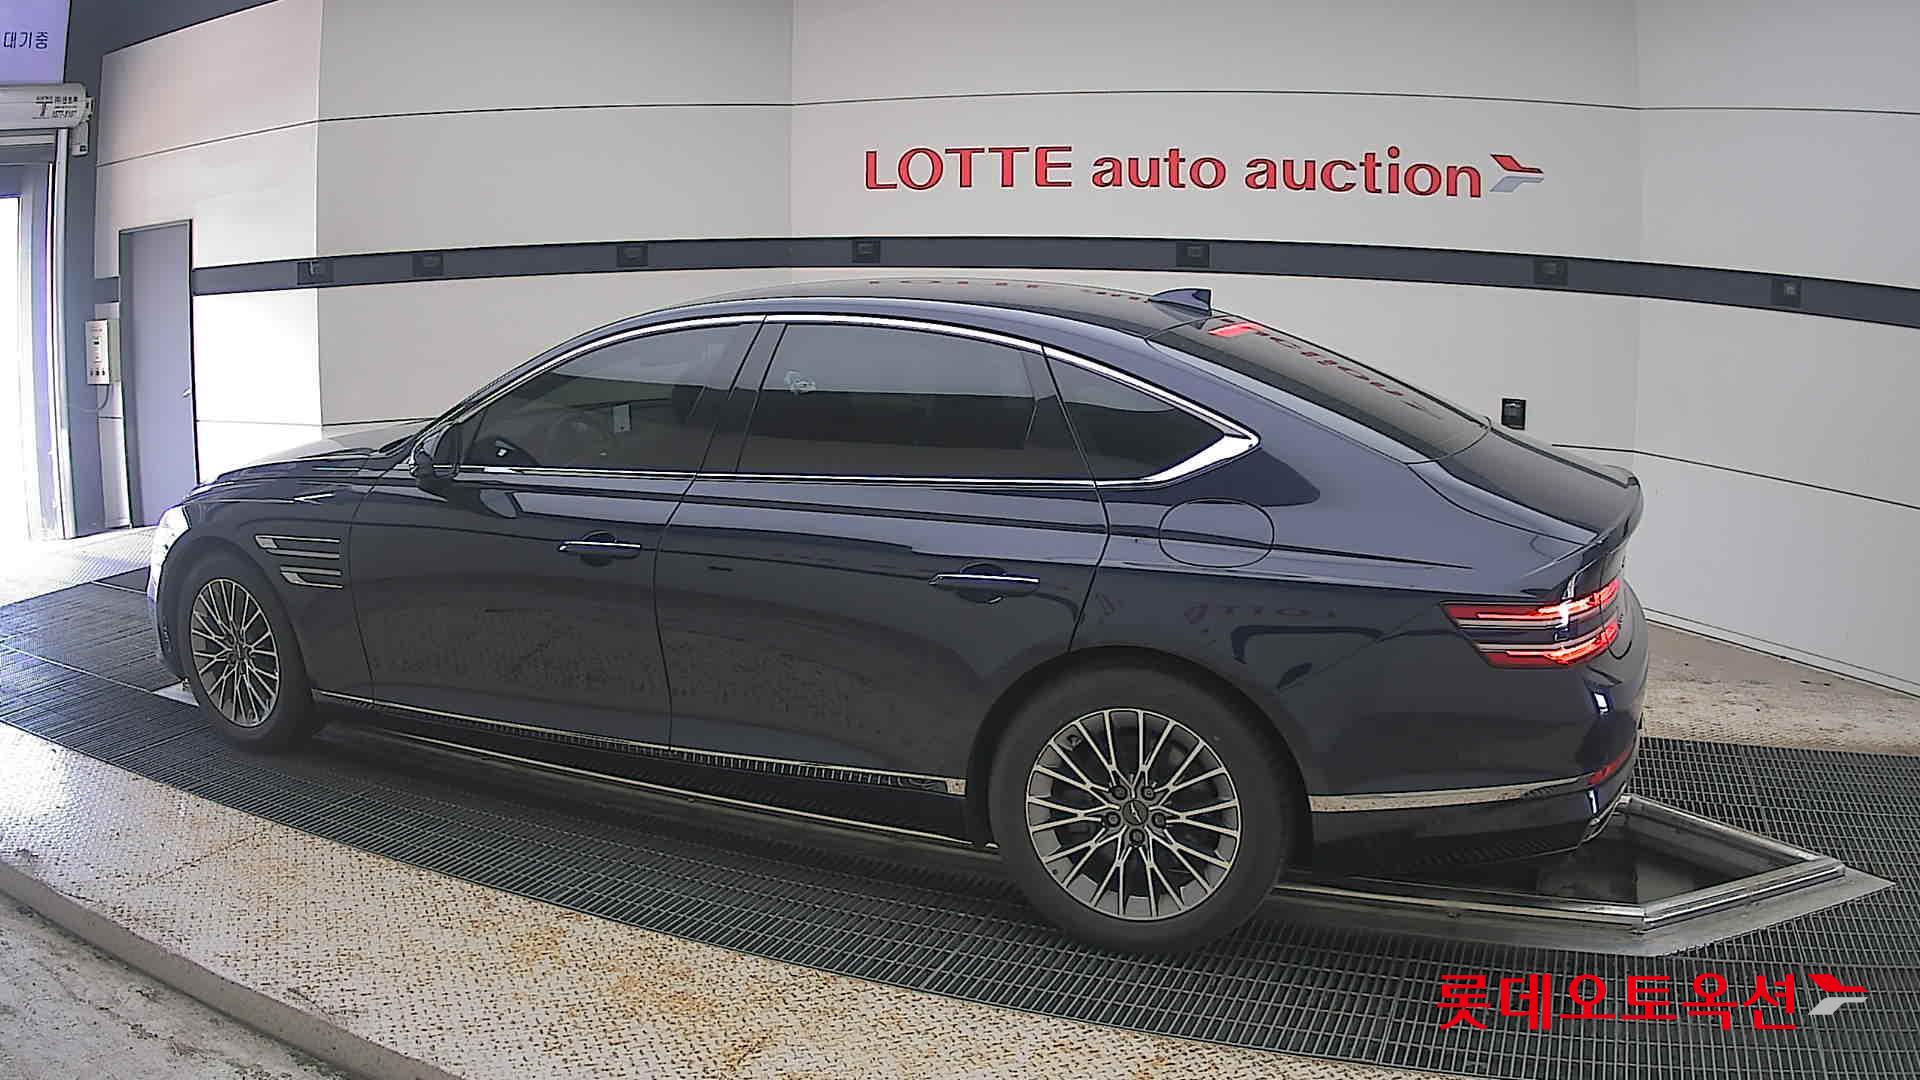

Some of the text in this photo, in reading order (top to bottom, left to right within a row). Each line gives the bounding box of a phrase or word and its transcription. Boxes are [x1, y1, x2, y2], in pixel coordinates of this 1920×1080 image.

[864, 145, 1482, 198] LOTTE auto auction
